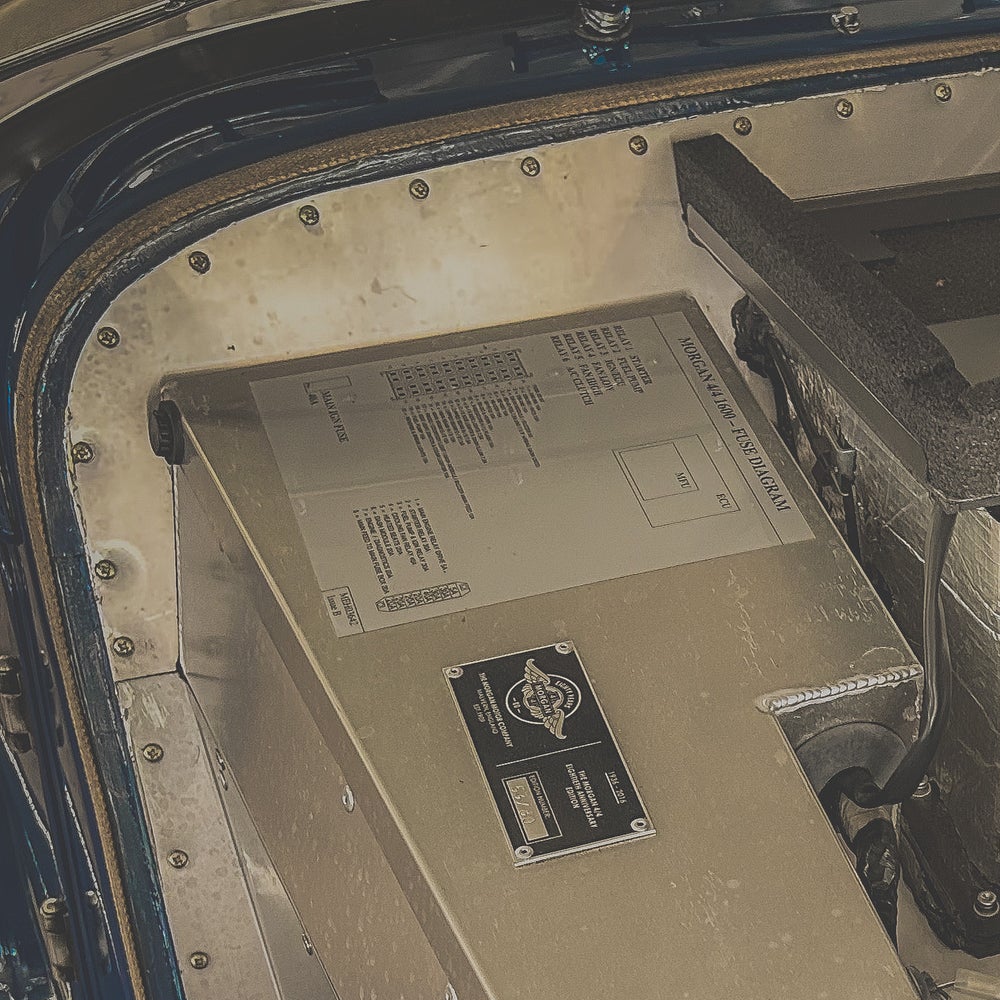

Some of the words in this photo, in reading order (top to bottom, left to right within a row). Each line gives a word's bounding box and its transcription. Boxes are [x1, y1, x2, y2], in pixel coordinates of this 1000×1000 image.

[562, 333, 581, 355] RELAY
[574, 331, 593, 353] RELAY
[587, 329, 606, 351] RELAY
[599, 327, 619, 348] RELAY
[616, 357, 633, 374] FUEL
[626, 374, 644, 394] PUMP
[612, 325, 631, 346] RELAY
[629, 355, 653, 385] STARTER
[676, 336, 715, 382] MORGAN
[549, 335, 568, 357] RELAY
[572, 377, 594, 405] CLUTCH
[578, 363, 593, 378] FAN
[591, 361, 606, 375] FAN
[585, 377, 602, 396] HIGH
[598, 375, 614, 392] LOW
[703, 382, 724, 397] 4/4
[320, 390, 336, 410] MAIN
[713, 398, 737, 419] 1600
[327, 409, 342, 424] IGN
[333, 424, 349, 443] FUSE
[730, 427, 758, 455] FUSE
[673, 471, 692, 489] MFU
[747, 456, 791, 511] DIAGRAM
[713, 492, 732, 510] ECU
[390, 512, 404, 532] COOLING
[416, 507, 427, 518] MAIN
[355, 518, 366, 531] MAIN
[373, 515, 383, 528] DASH
[378, 528, 391, 547] MODULE
[381, 513, 394, 531] HEATED
[388, 531, 400, 546] SEATS
[407, 508, 421, 529] STARTER
[415, 528, 427, 543] RELAY
[421, 518, 433, 535] ENGINE
[359, 530, 371, 543] FEED
[364, 516, 376, 534] ENGINE
[372, 538, 390, 569] DIAGNOSTICS
[364, 542, 373, 550] TO
[398, 532, 408, 542] FAN
[399, 510, 409, 521] FUEL
[404, 522, 415, 535] PUMP
[414, 548, 426, 563] RELAY
[428, 535, 440, 550] RELAY
[366, 549, 378, 562] MAIN
[402, 542, 414, 557] RELAY
[434, 550, 446, 564] DRIVE
[371, 561, 383, 574] FUSE
[376, 574, 387, 585] BOX
[326, 594, 340, 610] Issue
[478, 672, 487, 681] THE
[481, 681, 496, 704] MORGAN
[533, 684, 551, 714] MORGAN
[490, 703, 503, 721] MOTOR
[497, 721, 513, 748] COMPANY
[528, 774, 542, 795] EDITION
[577, 770, 588, 780] THE
[564, 763, 582, 790] EIGHTIETH
[575, 790, 598, 828] ANNIVERSARY
[581, 780, 599, 806] MORGAN
[607, 771, 619, 785] 1936
[615, 789, 627, 803] 2016
[564, 786, 580, 808] EDITION
[591, 806, 603, 817] 4/4
